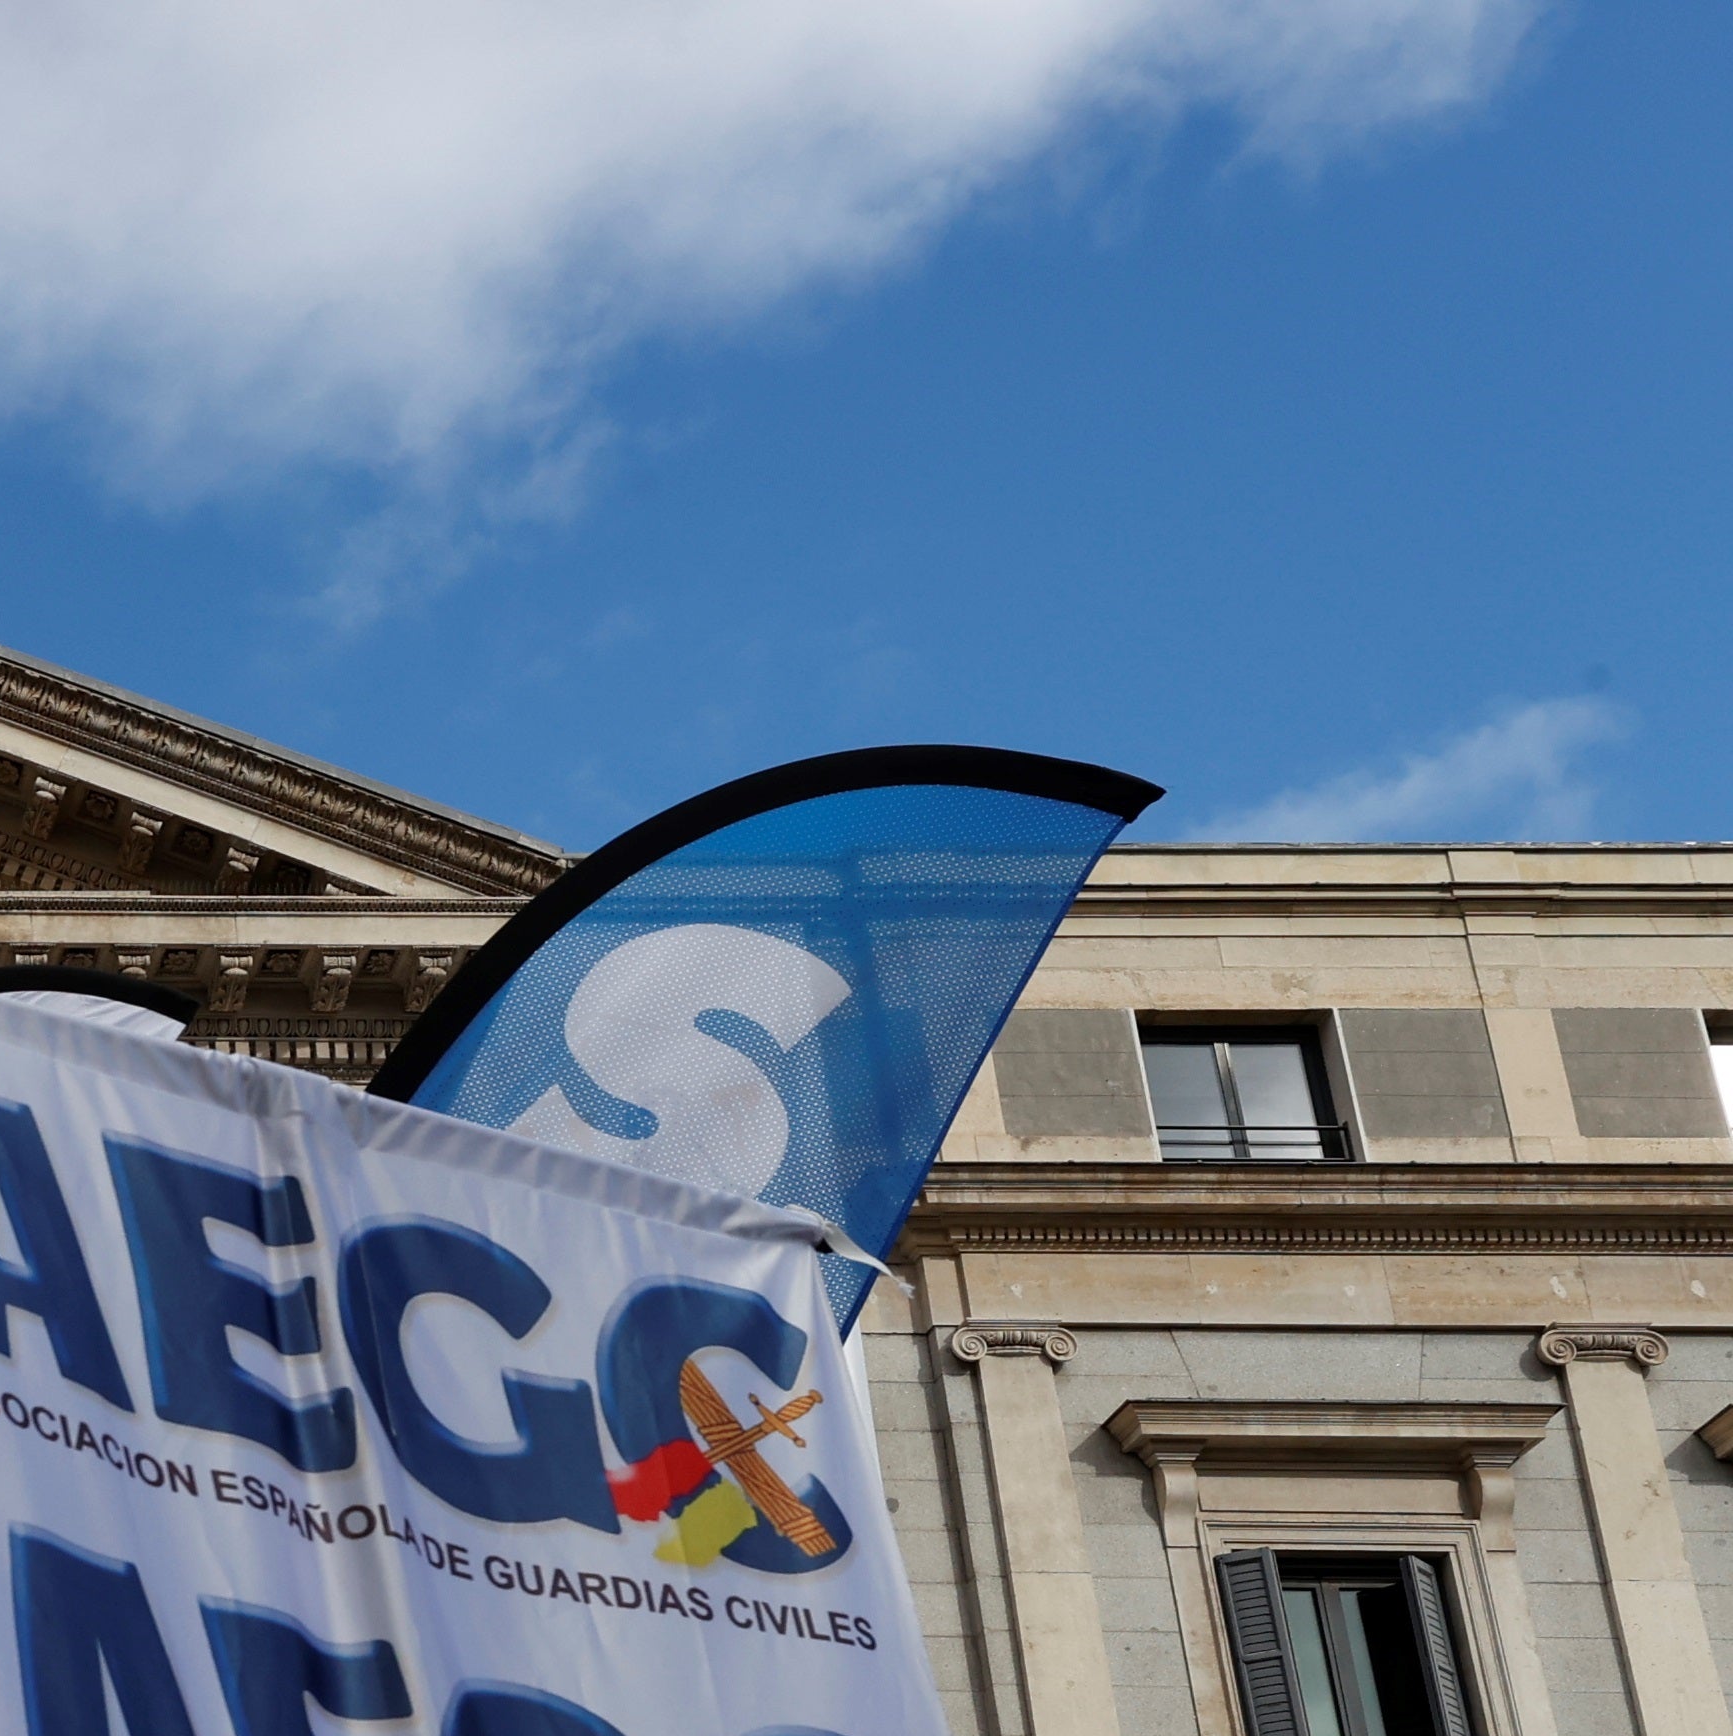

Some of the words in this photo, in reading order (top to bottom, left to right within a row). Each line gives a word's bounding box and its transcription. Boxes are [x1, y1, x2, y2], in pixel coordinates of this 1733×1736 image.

[210, 1469, 423, 1556] ESPAÑOLA
[424, 1533, 474, 1581] DE
[483, 1554, 714, 1622] GUARDIAS
[725, 1594, 877, 1651] CIVILES
